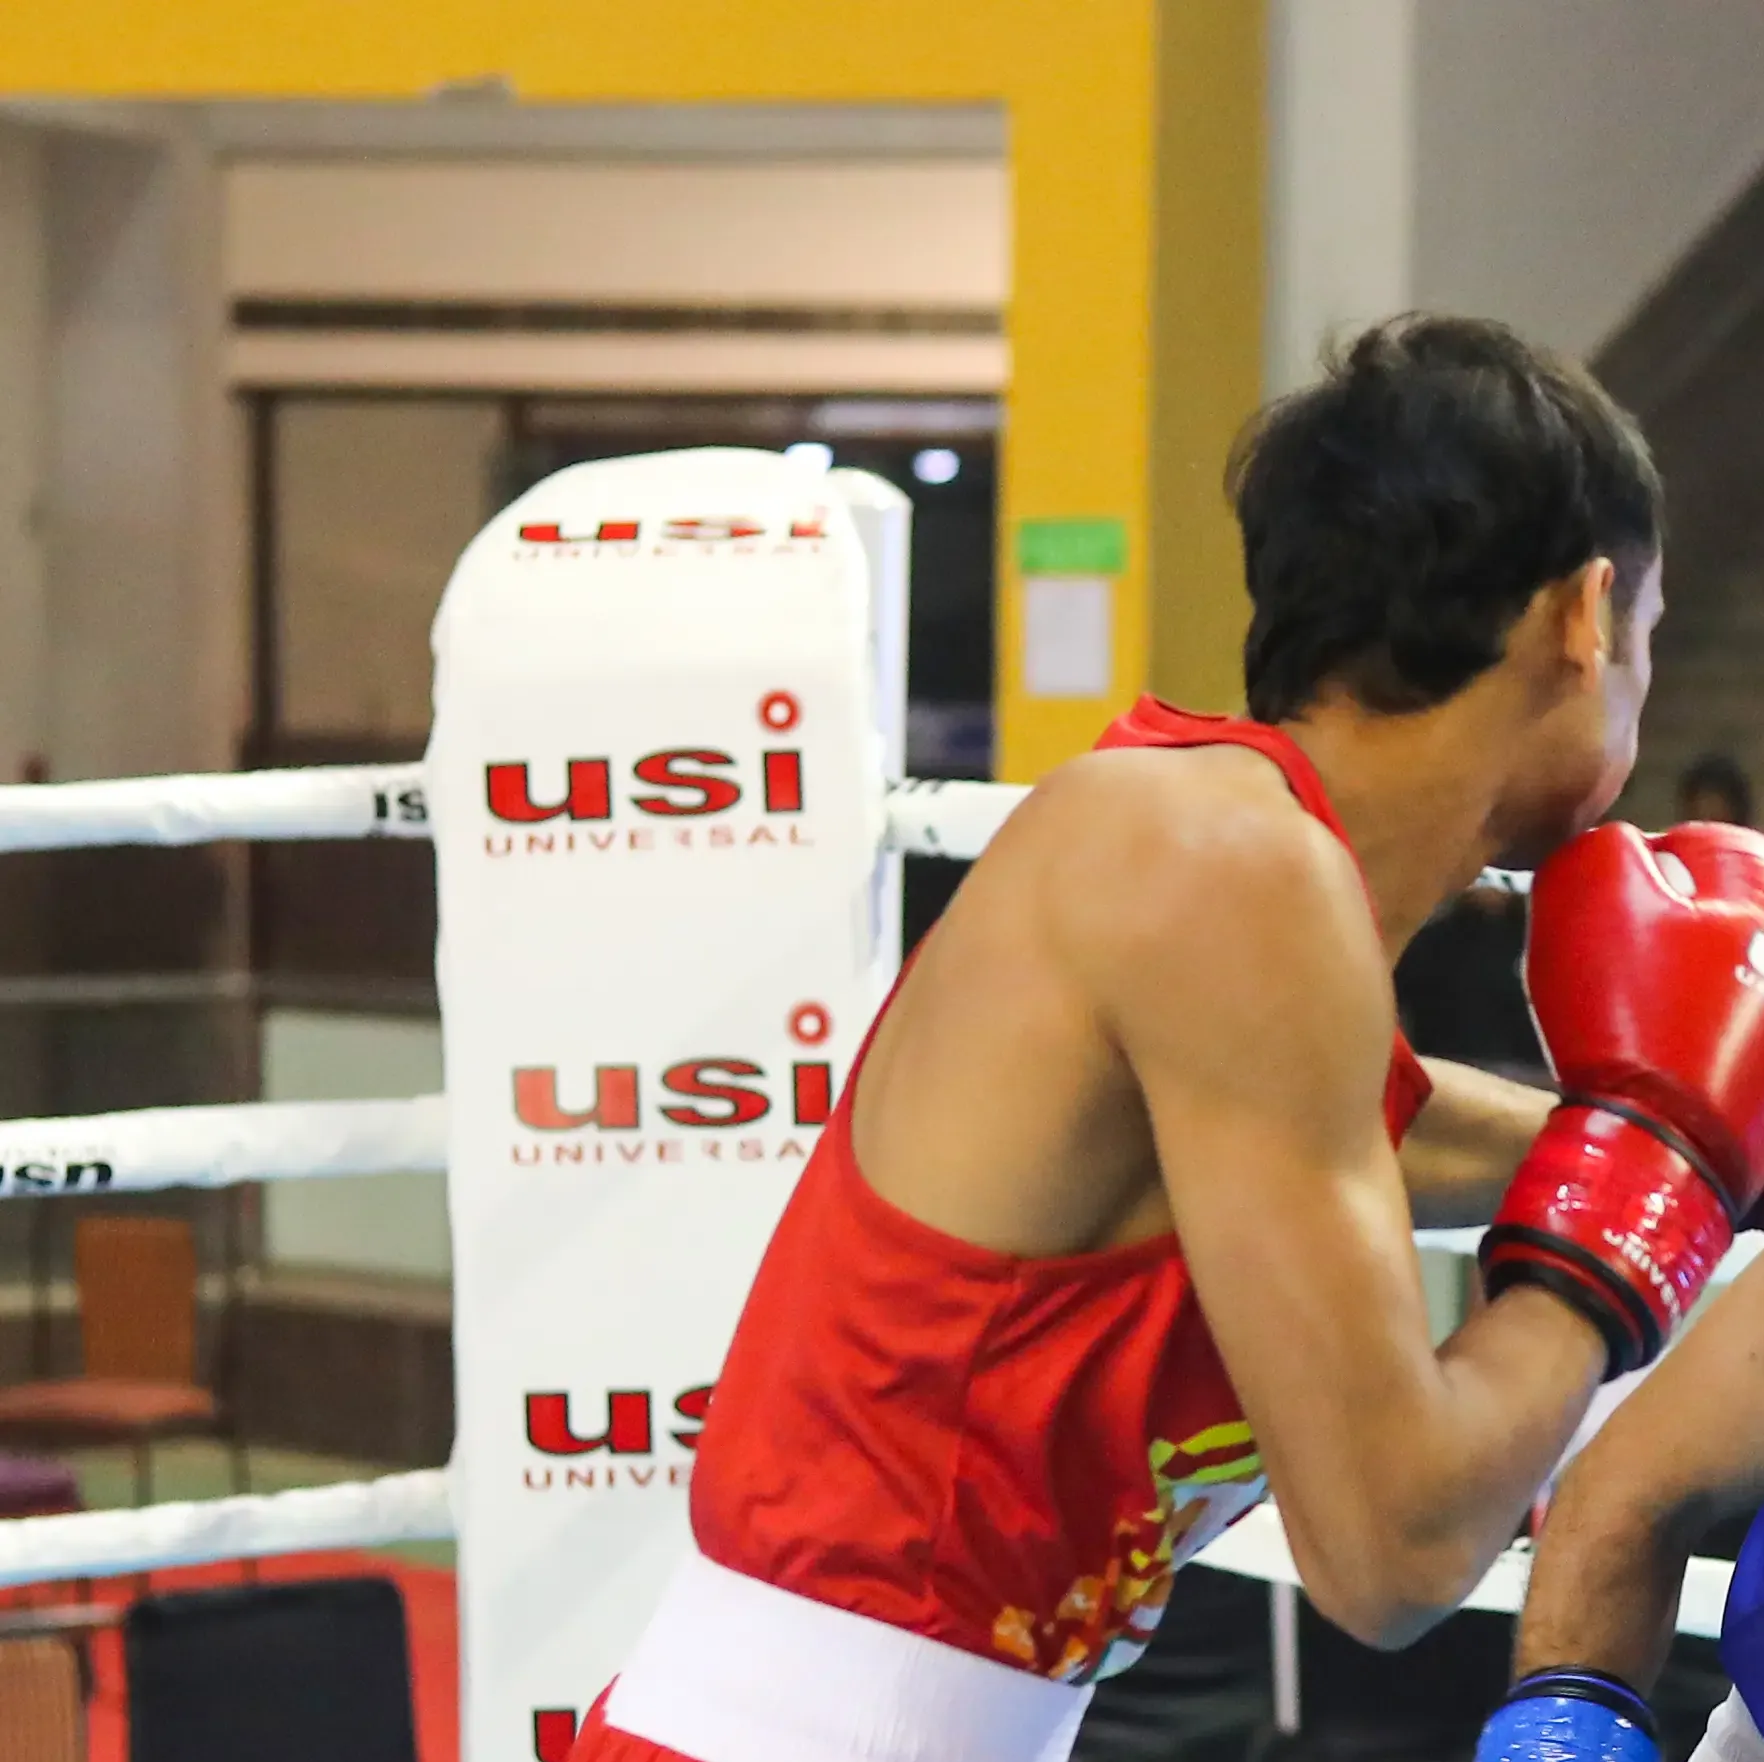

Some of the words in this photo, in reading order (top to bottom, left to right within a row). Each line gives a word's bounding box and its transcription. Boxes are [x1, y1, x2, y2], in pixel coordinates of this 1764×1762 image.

[484, 688, 804, 825] usi
[483, 826, 814, 857] UNIVERSAL
[511, 999, 832, 1131] usi
[511, 1138, 806, 1165] UNIVERSA
